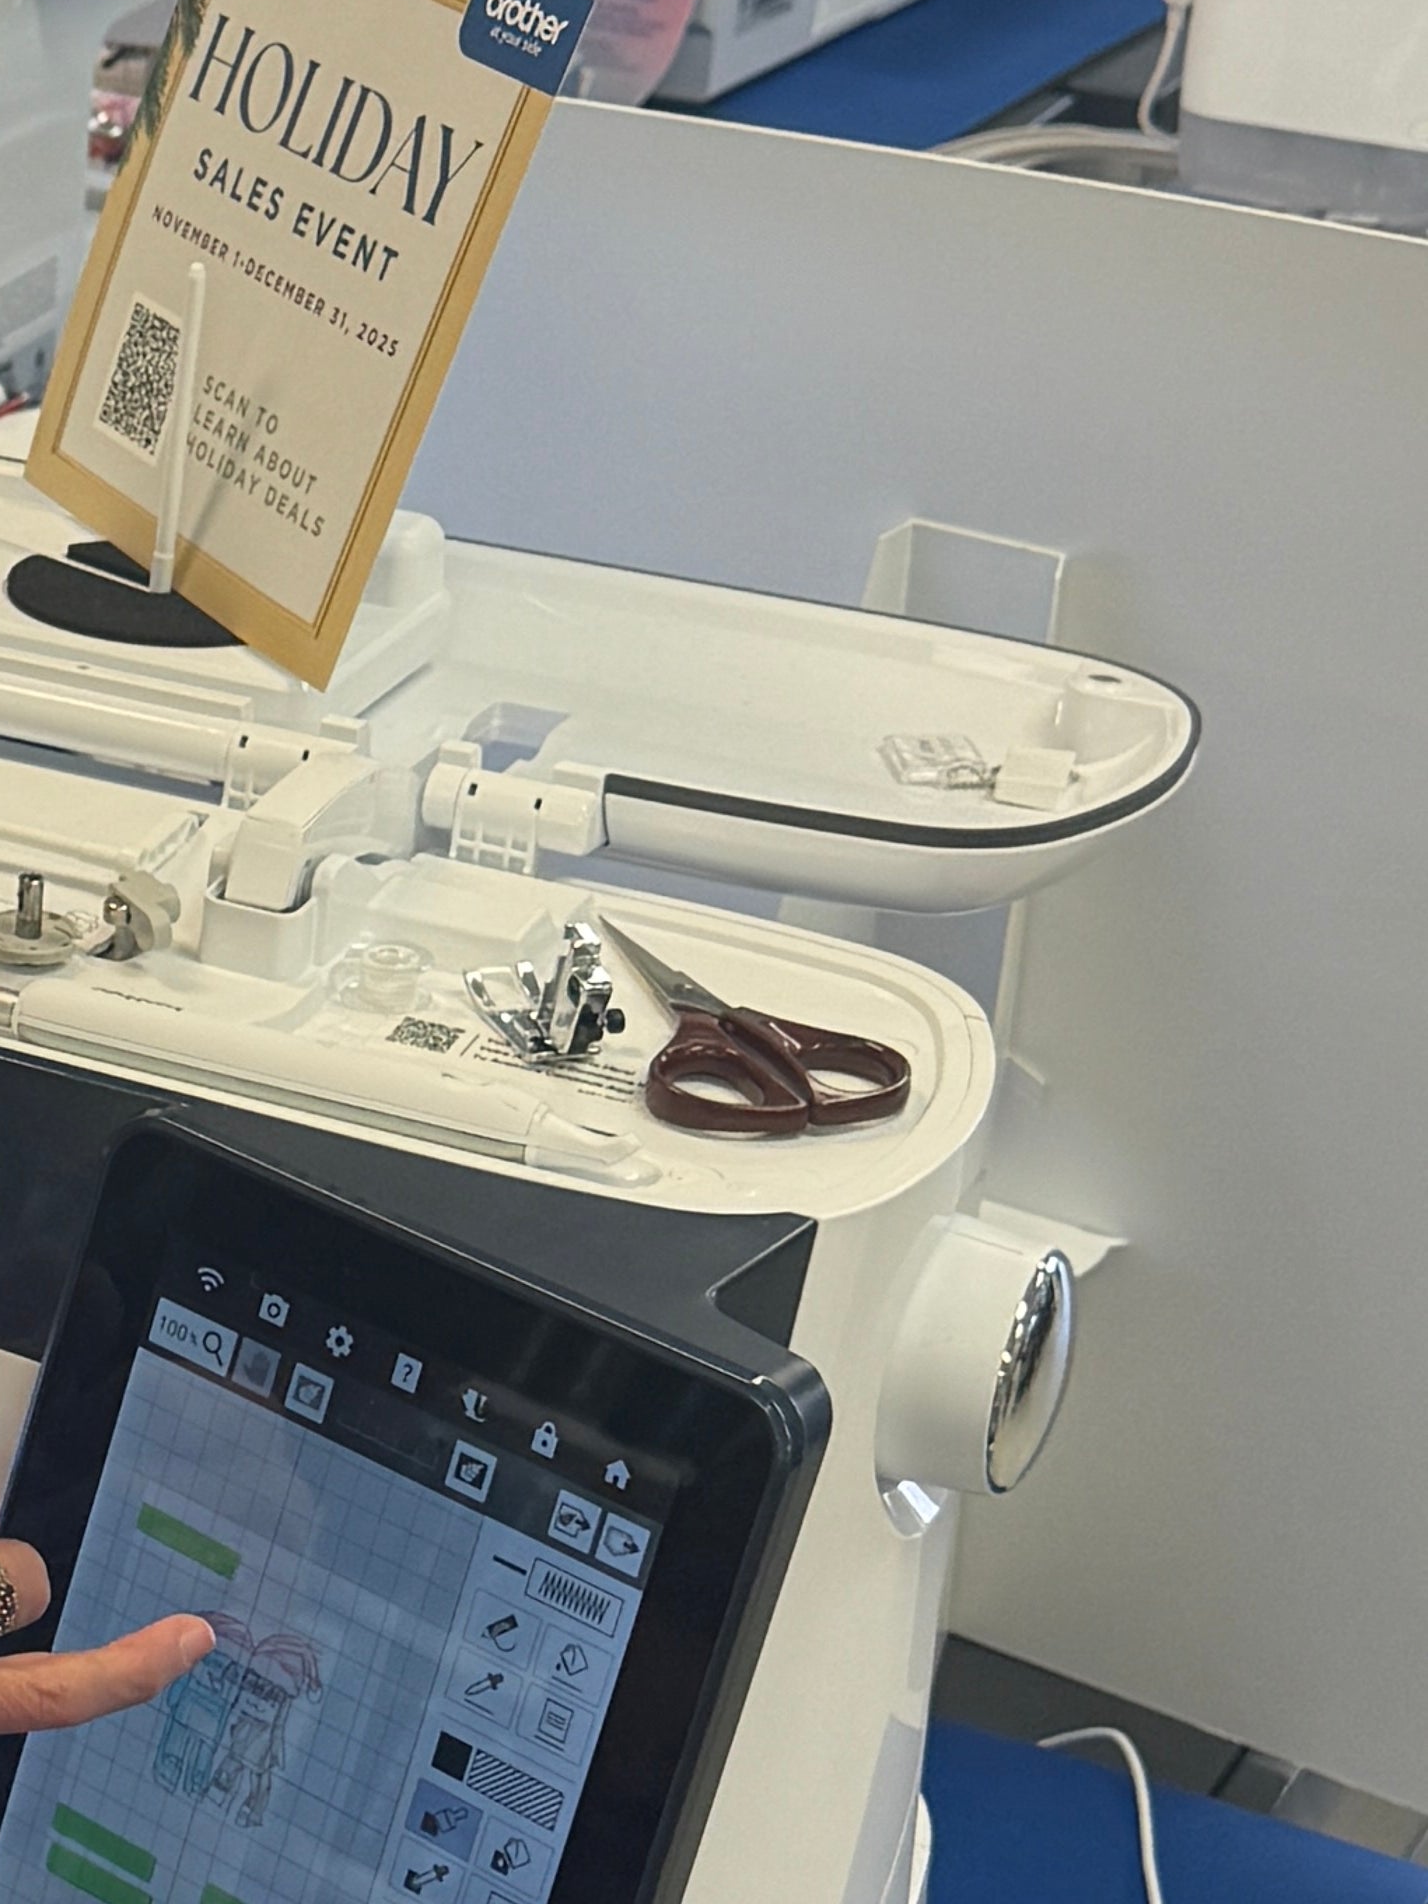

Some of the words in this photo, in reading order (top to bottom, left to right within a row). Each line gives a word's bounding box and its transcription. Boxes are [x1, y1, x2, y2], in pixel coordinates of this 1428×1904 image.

[189, 13, 484, 227] HOLIDAY
[193, 147, 285, 221] SALES
[292, 202, 400, 282] EVENT
[151, 205, 229, 260] NOVEMBER
[329, 307, 350, 335] 31,
[356, 322, 400, 358] 2025
[192, 403, 250, 453] LEARN
[253, 445, 318, 495] ABOUT
[202, 375, 251, 418] SCAN
[255, 406, 279, 435] TO
[264, 485, 326, 537] DEALS
